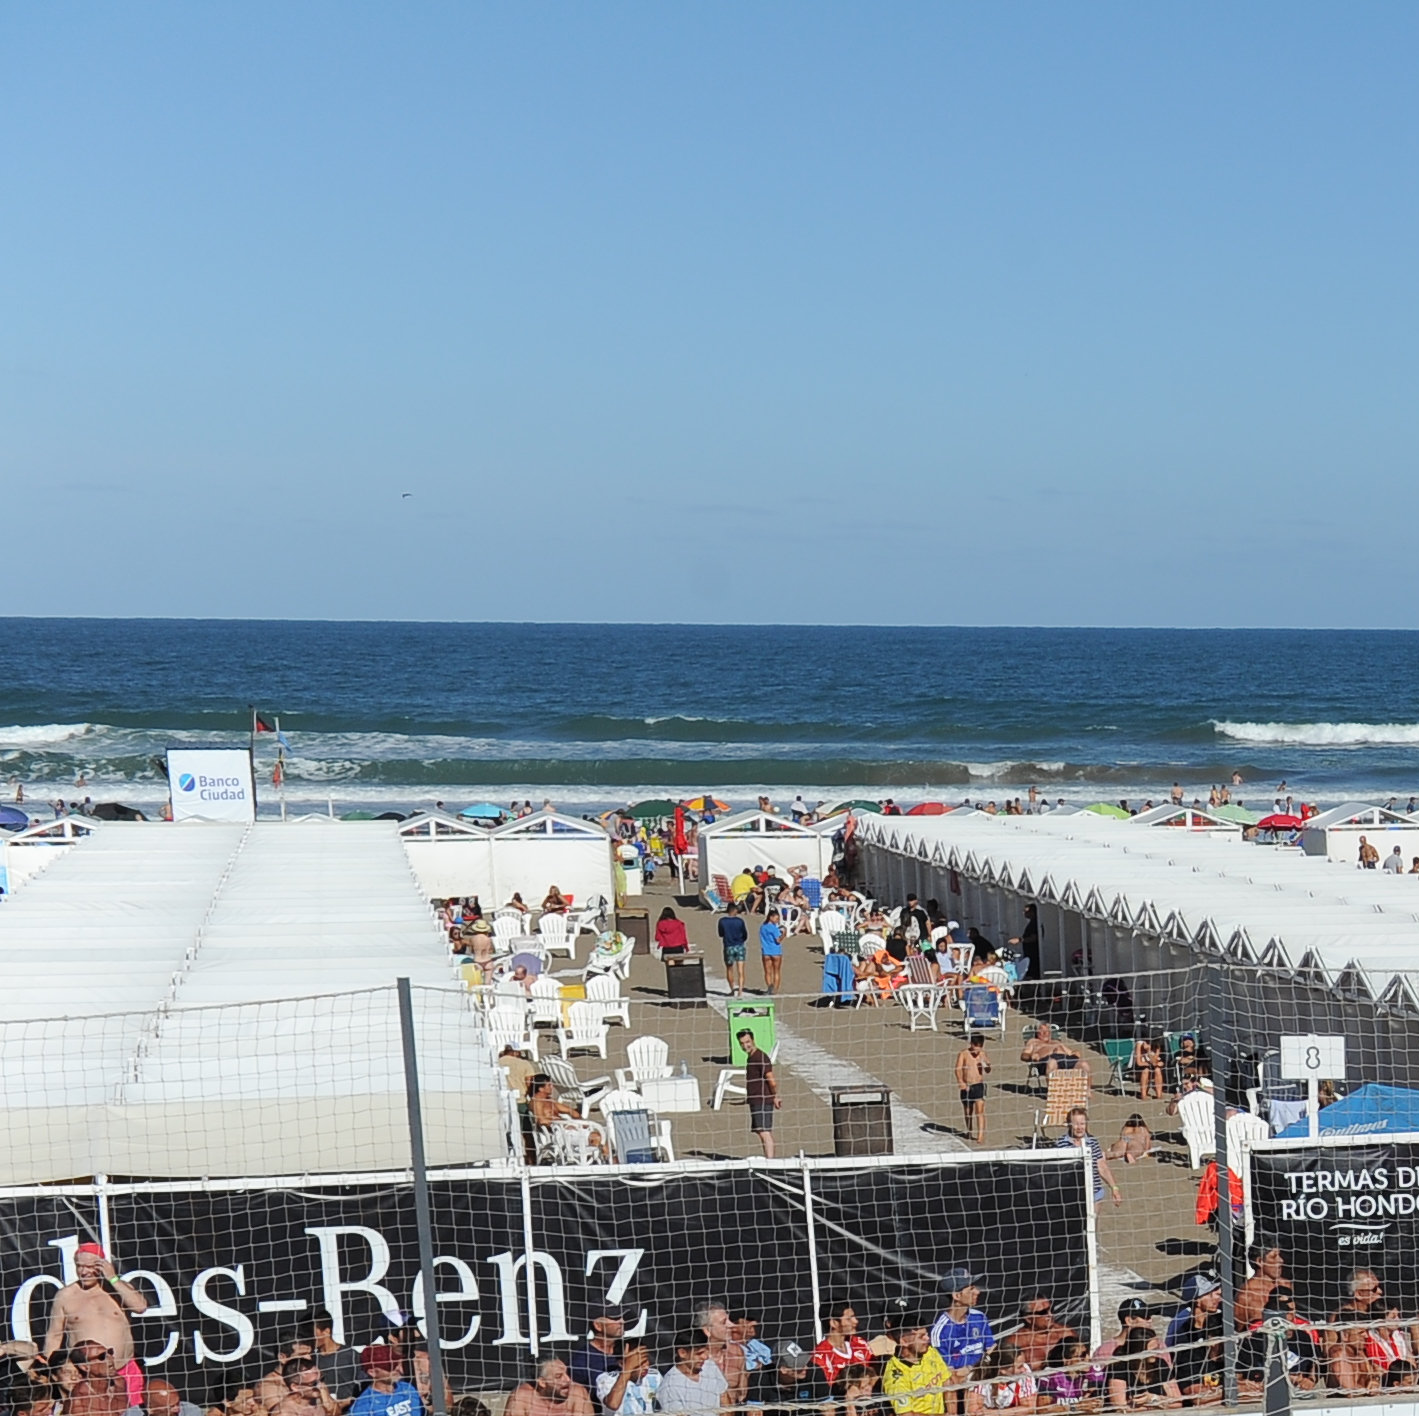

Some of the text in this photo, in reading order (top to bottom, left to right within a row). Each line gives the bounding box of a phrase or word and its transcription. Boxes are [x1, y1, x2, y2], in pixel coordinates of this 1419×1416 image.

[199, 776, 240, 787] Banco
[200, 788, 245, 801] Ciudad
[1305, 1046, 1321, 1069] 8
[1284, 1168, 1389, 1194] TERMAS
[1280, 1194, 1328, 1221] RÍO
[1338, 1232, 1385, 1246] es vida!
